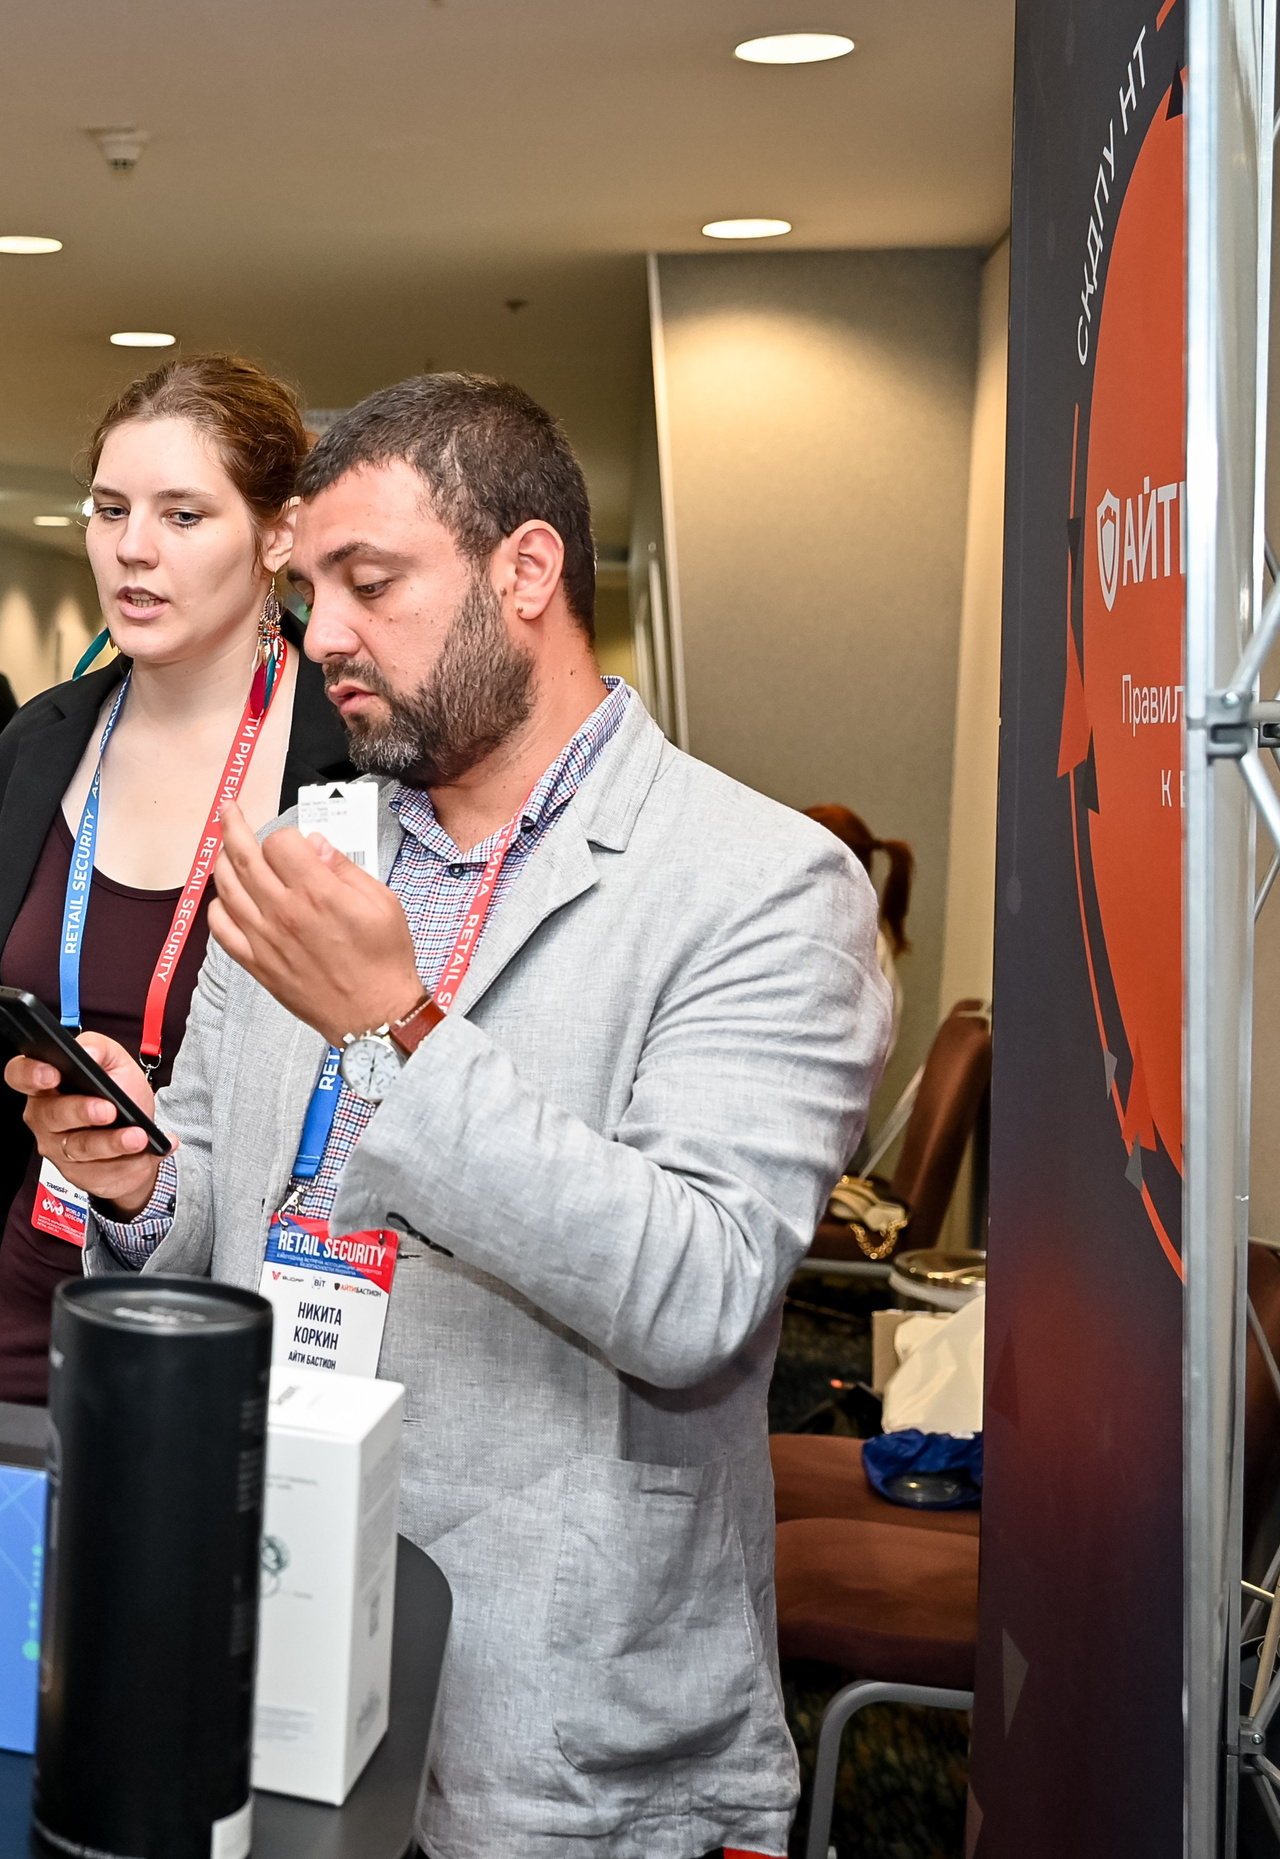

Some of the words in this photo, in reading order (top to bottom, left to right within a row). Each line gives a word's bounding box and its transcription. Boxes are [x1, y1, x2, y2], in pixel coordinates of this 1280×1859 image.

[1119, 24, 1146, 136] НТ
[72, 807, 96, 892] SECURITY
[183, 835, 217, 897] RETAIL
[64, 893, 85, 954] RETAIL
[156, 895, 195, 983] SECURITY
[437, 912, 481, 994] RETAIL
[318, 1047, 340, 1092] RET
[277, 1230, 320, 1257] RETAIL
[323, 1237, 387, 1267] SECURITY
[293, 1325, 339, 1350] КОРКИН
[297, 1301, 342, 1326] НИКИТА
[288, 1350, 306, 1364] АЙТИ
[306, 1354, 336, 1370] БАСТИОН
